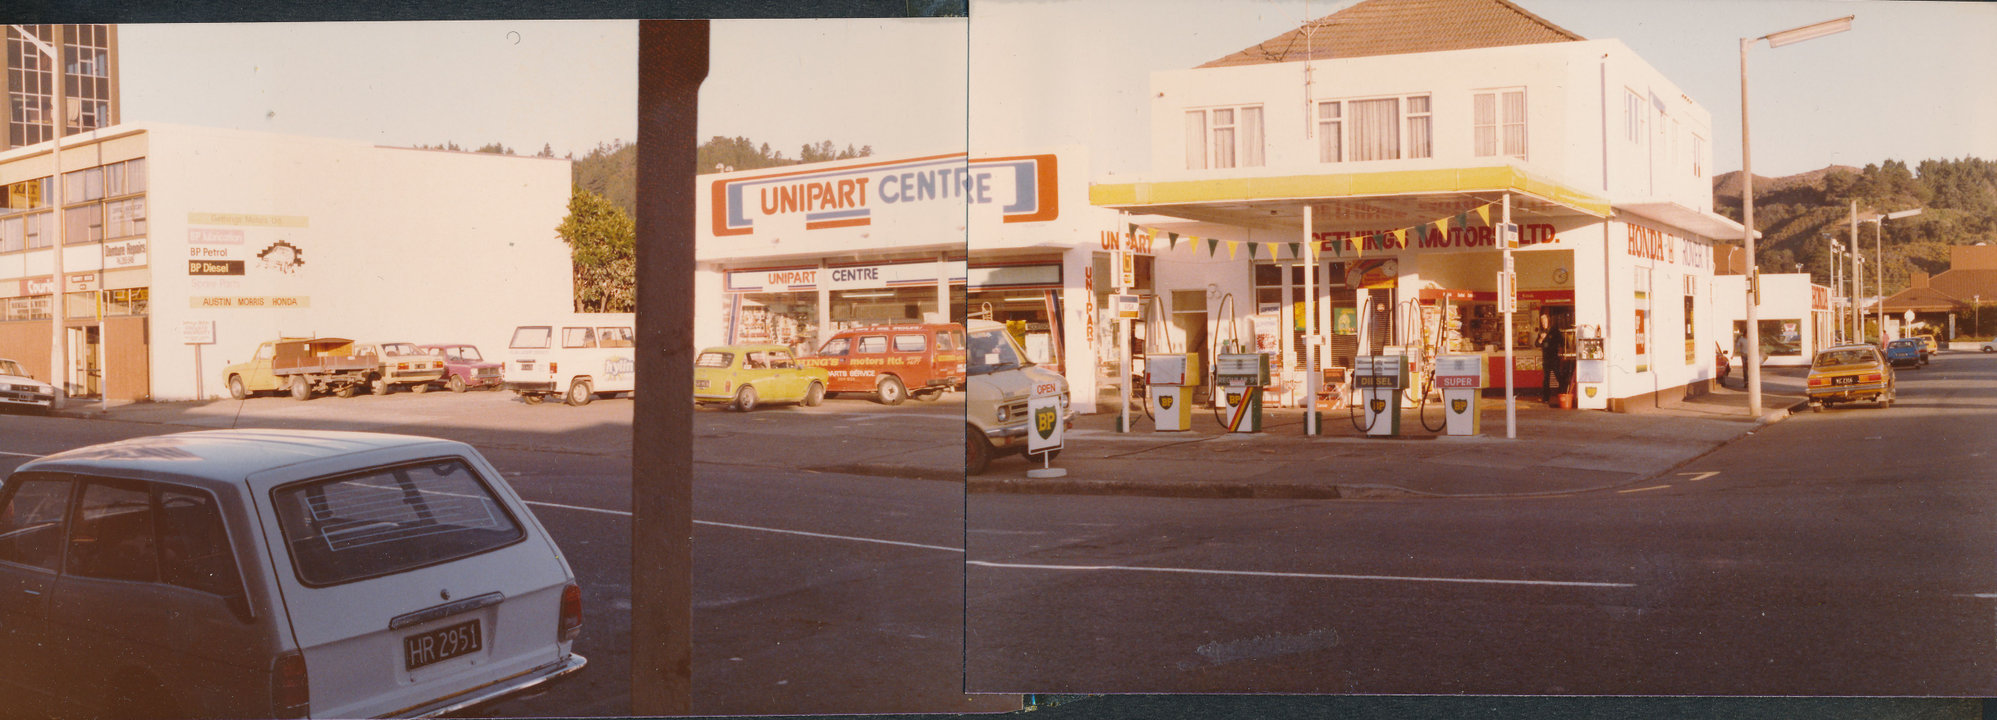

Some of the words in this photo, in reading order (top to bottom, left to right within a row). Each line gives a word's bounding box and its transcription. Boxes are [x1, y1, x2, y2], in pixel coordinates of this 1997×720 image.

[761, 177, 869, 215] UNIPART
[878, 168, 992, 204] CENTRE
[1418, 225, 1496, 248] MOTOR
[1517, 223, 1560, 246] LTD.
[1101, 231, 1151, 254] UNPART
[1628, 223, 1664, 261] HONDA
[190, 247, 201, 256] BP
[203, 247, 228, 256] Petrol
[190, 263, 201, 272] BP
[203, 263, 228, 272] Diesel
[768, 271, 817, 285] UNIPART
[832, 268, 879, 282] CENTRE
[203, 298, 231, 306] AUSTIN
[238, 298, 265, 306] MORRIS
[272, 298, 298, 306] HONDA
[1085, 266, 1094, 350] UNIPART
[851, 357, 884, 366] motors
[850, 369, 875, 377] SERVICE
[1444, 377, 1472, 386] SUPER
[1036, 383, 1056, 395] OPEN
[1161, 397, 1173, 407] BP
[1229, 395, 1241, 404] BP
[1454, 401, 1466, 410] BP
[1038, 412, 1055, 432] BP
[410, 636, 435, 666] HR
[439, 624, 478, 658] 2951
